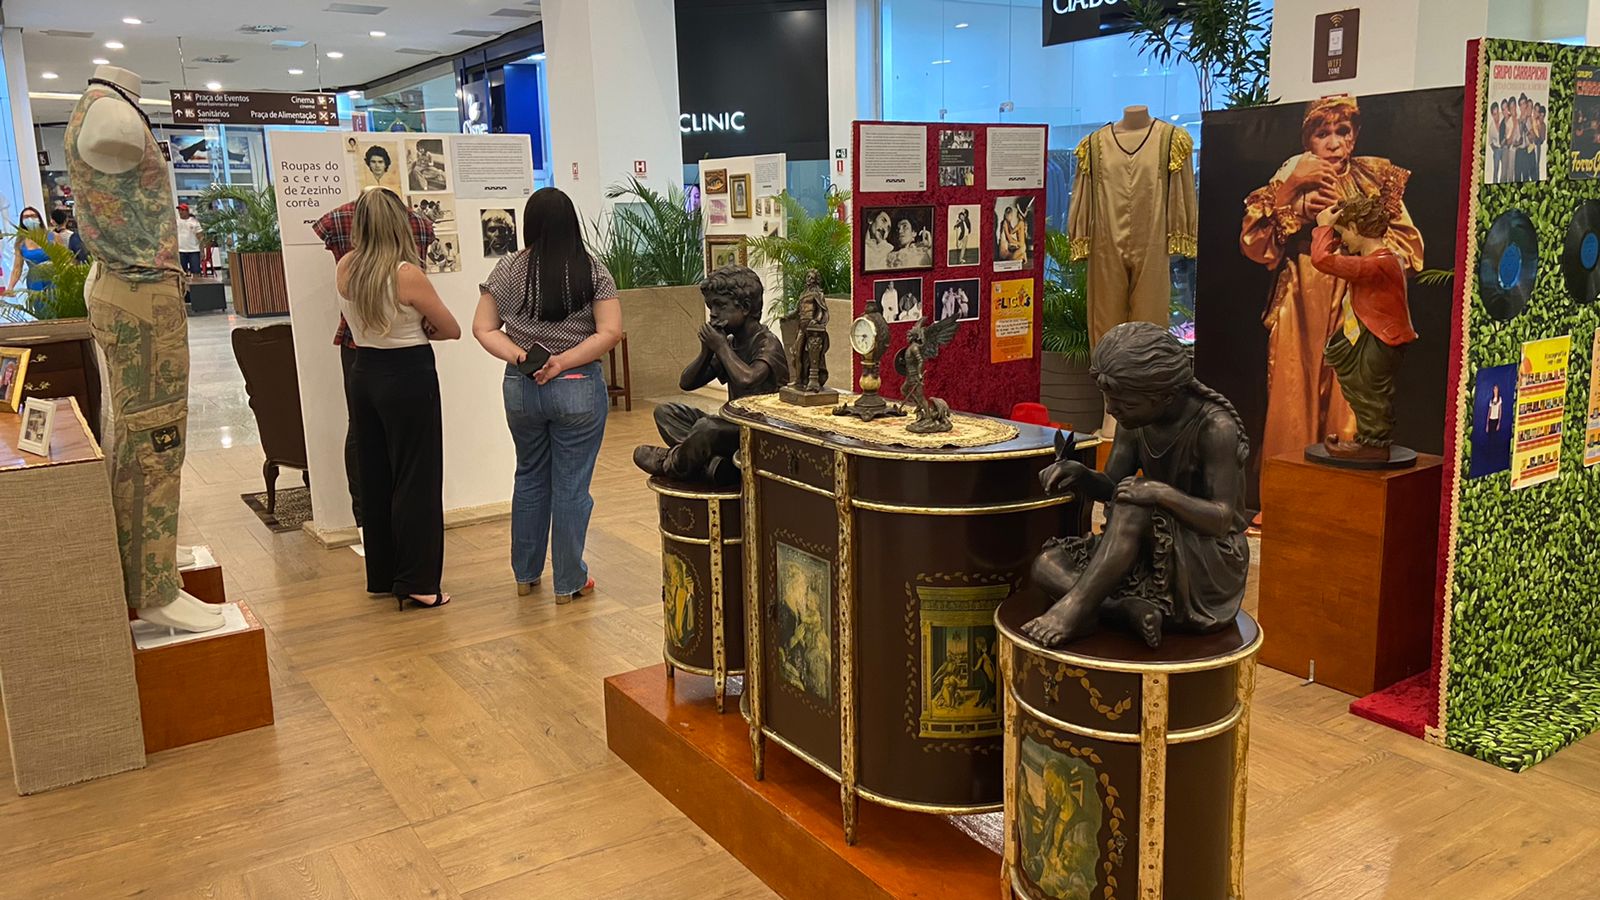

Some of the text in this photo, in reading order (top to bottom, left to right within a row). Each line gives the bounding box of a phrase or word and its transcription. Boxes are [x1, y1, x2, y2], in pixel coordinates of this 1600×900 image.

[1328, 58, 1342, 67] WIFI
[1328, 67, 1340, 75] ZONE
[1494, 65, 1512, 80] GRUPO
[195, 94, 250, 103] Praça de Eventos
[291, 96, 315, 104] Cinema
[197, 109, 230, 118] Sanitários
[250, 110, 269, 119] Praça
[278, 111, 317, 120] Alimentação
[679, 111, 745, 132] CLINIC
[281, 161, 339, 173] Roupas do
[284, 185, 341, 196] de Zezinho
[286, 198, 320, 208] corrêa
